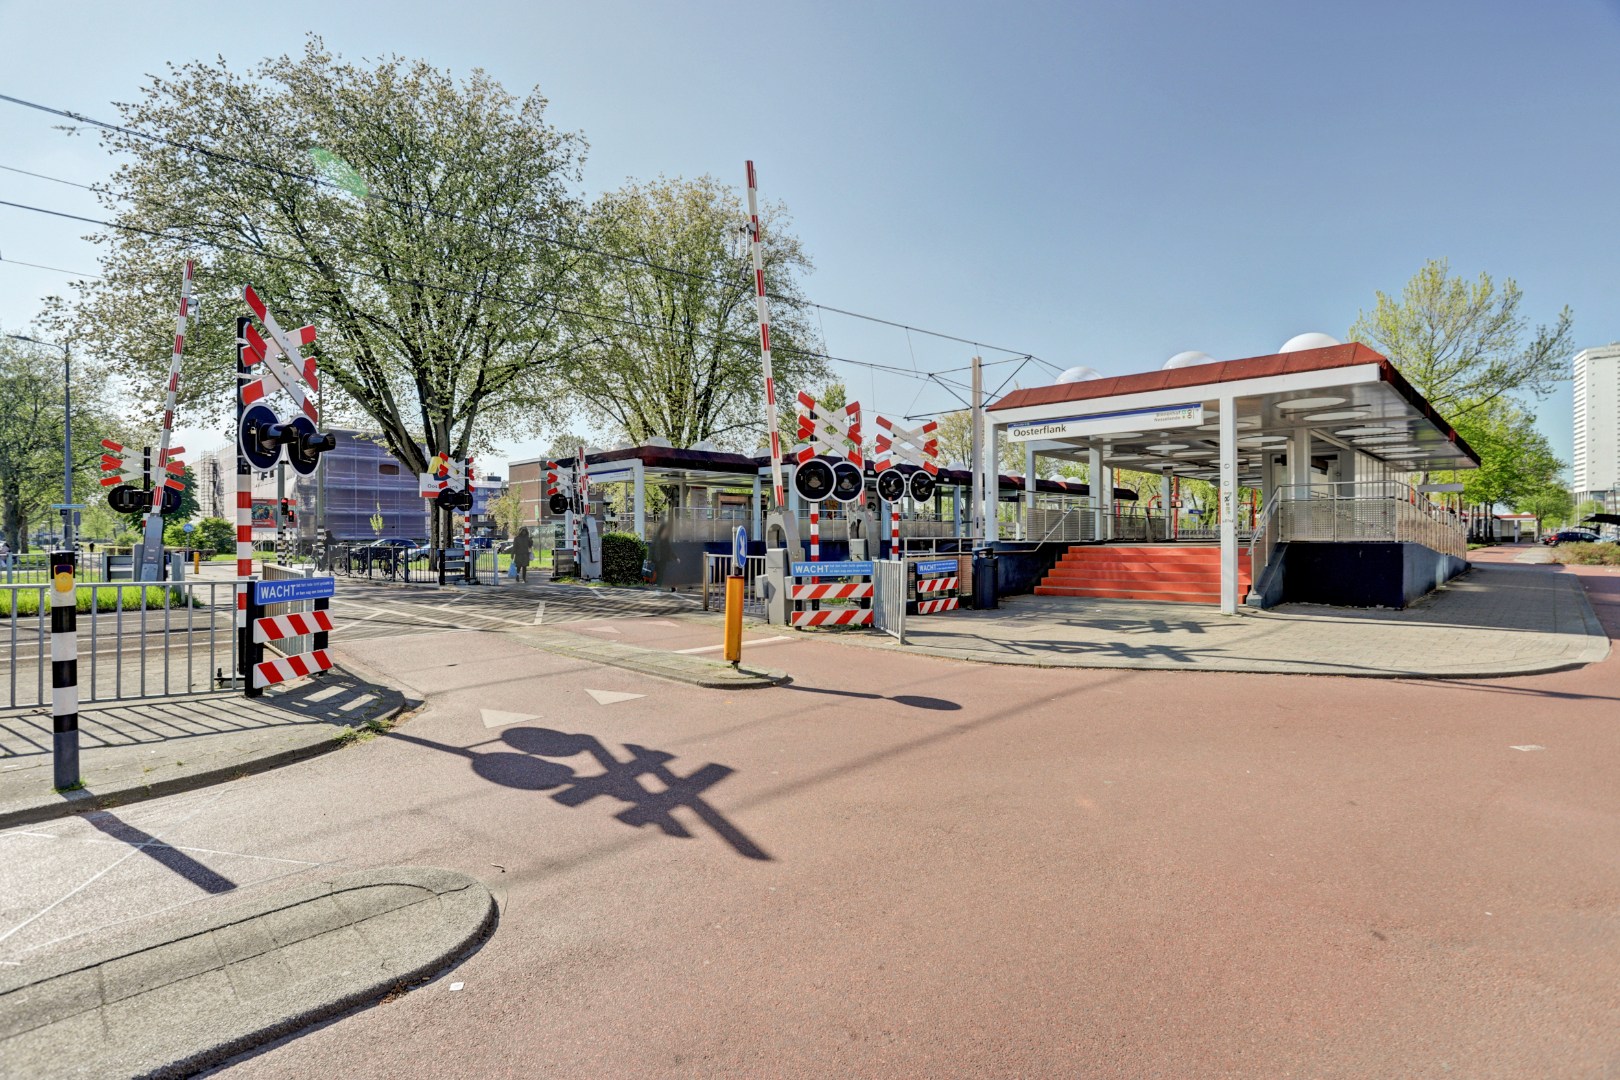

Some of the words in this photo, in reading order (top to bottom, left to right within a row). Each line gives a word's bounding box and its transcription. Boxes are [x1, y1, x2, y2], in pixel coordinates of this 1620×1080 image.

[1013, 424, 1067, 437] Oosterflank
[795, 564, 829, 574] WACHT
[260, 584, 296, 599] WACHT
